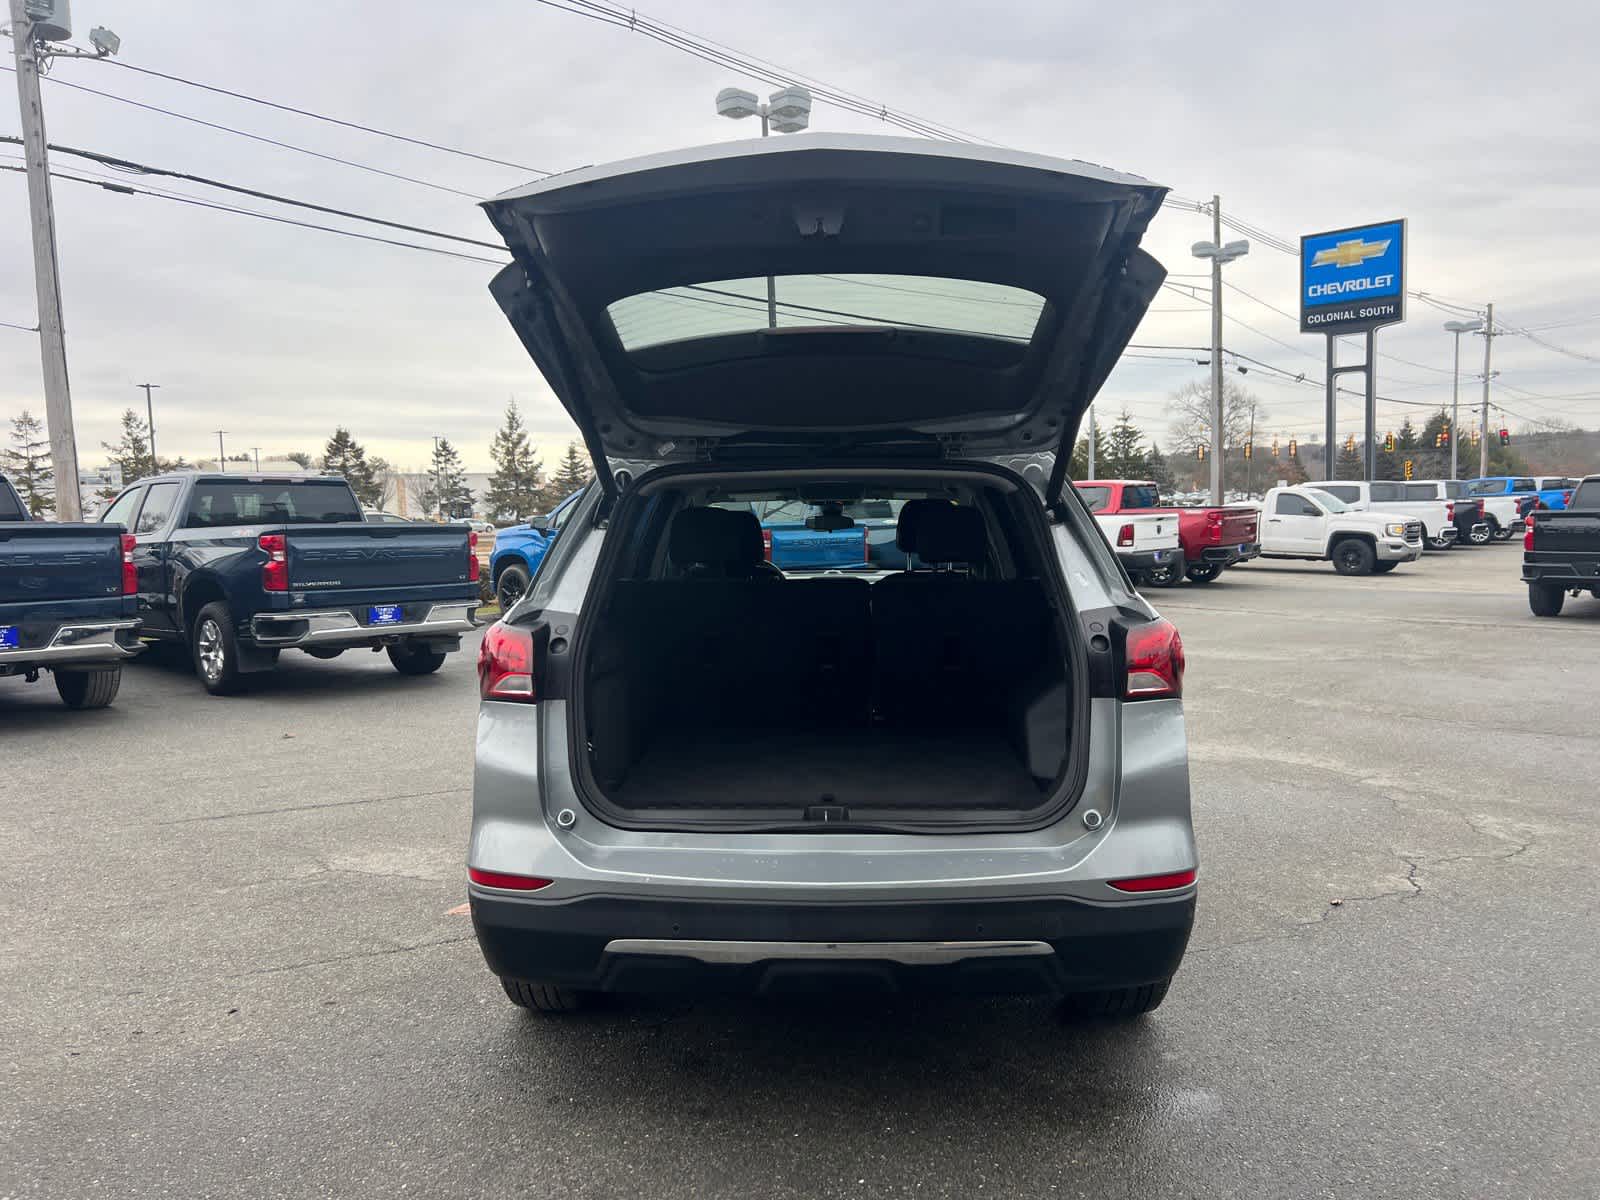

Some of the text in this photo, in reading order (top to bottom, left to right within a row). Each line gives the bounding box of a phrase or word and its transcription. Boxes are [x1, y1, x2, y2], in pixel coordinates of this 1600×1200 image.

[1308, 274, 1394, 297] CHEVROLET
[1307, 305, 1394, 324] COLONIAL SOUTH
